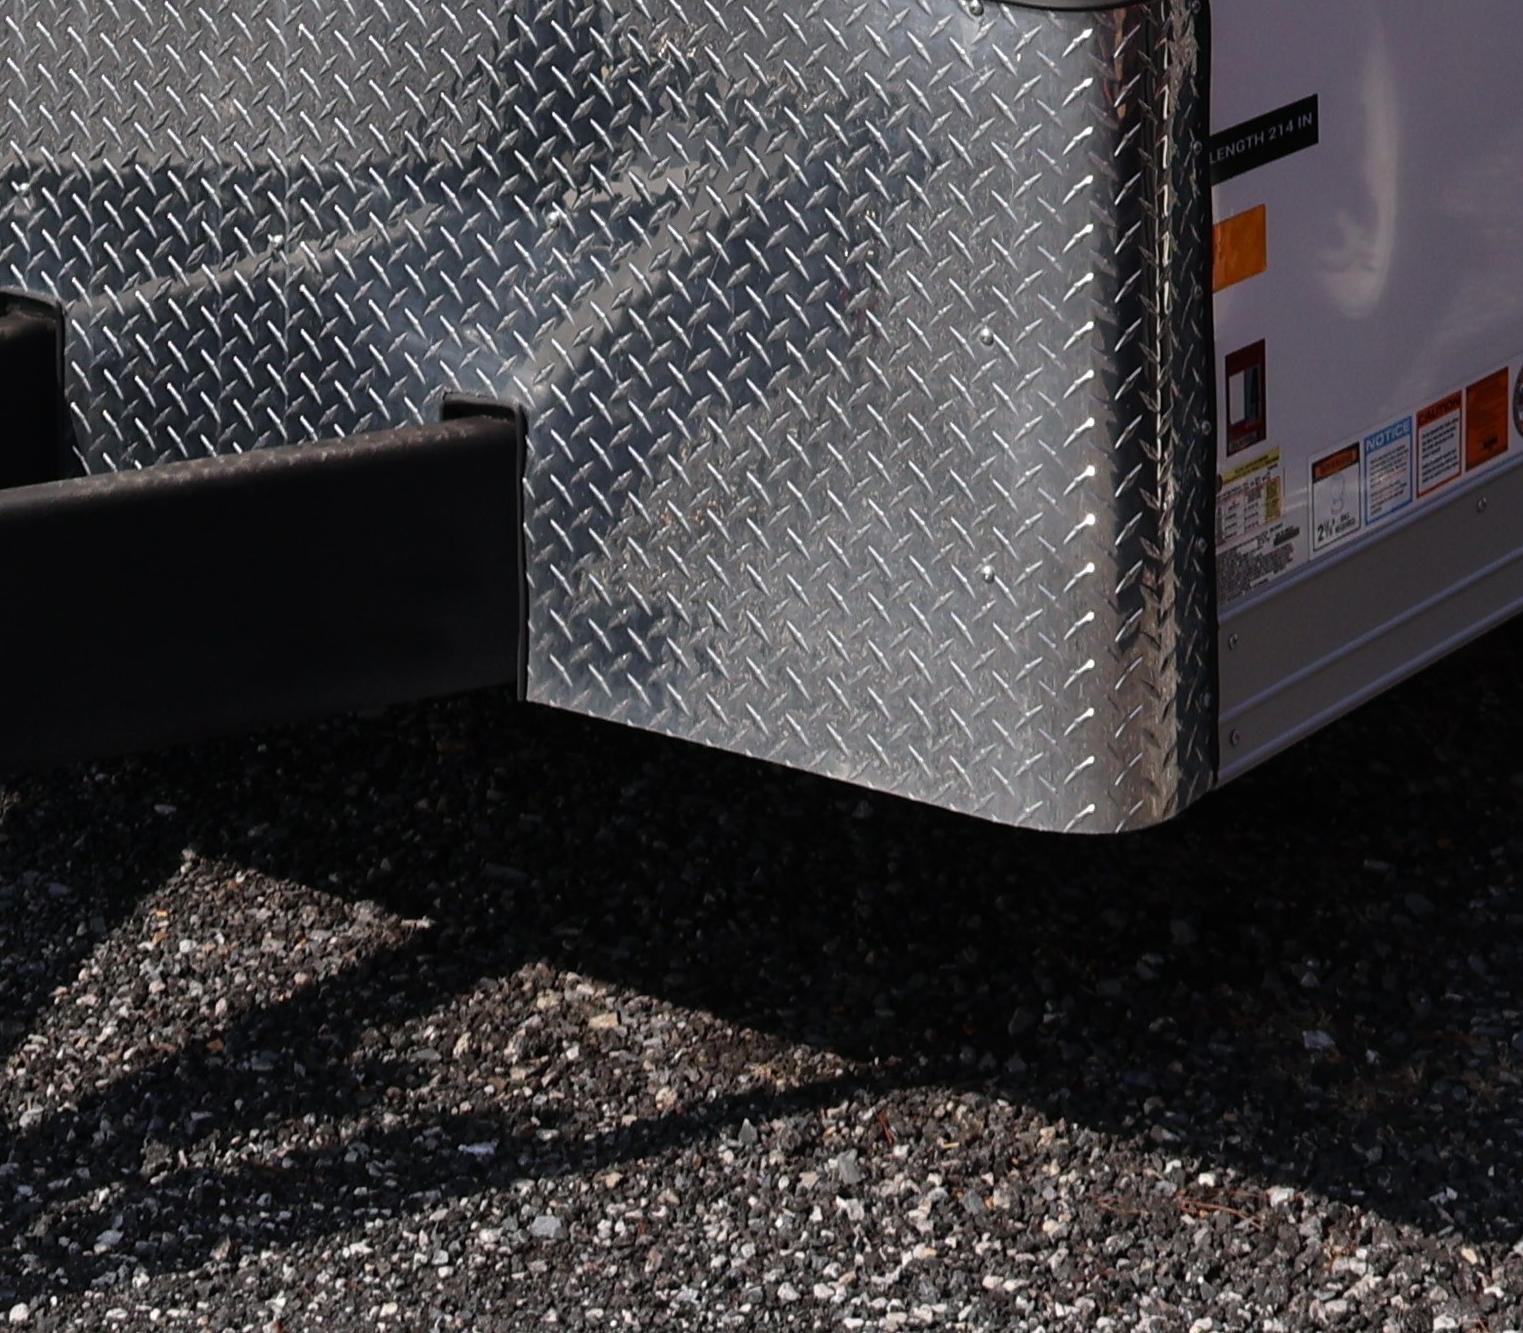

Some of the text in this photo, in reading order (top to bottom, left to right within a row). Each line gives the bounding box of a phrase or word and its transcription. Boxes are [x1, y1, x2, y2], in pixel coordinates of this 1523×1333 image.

[1209, 112, 1313, 165] LENGTH 214 IN
[1365, 420, 1411, 451] NOTICE
